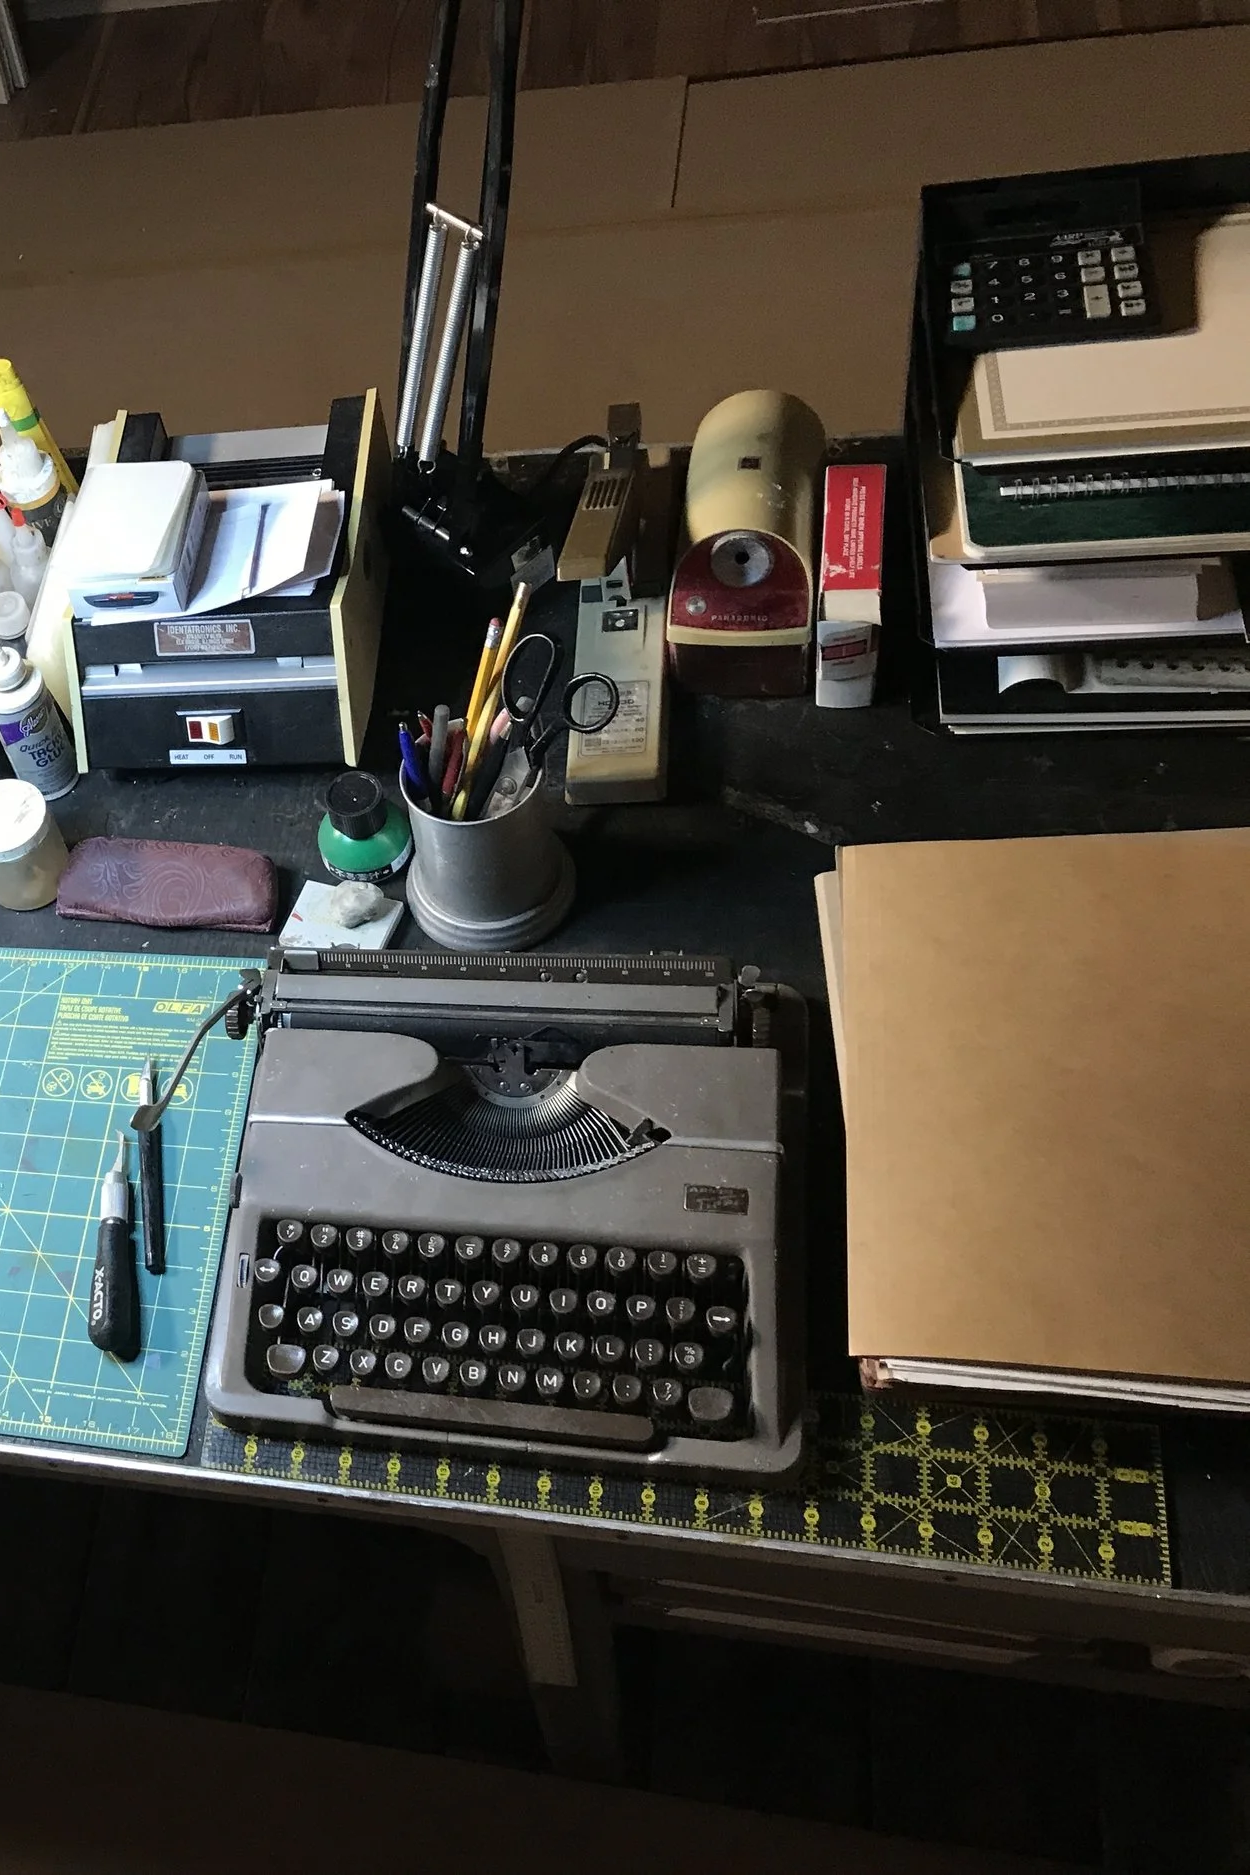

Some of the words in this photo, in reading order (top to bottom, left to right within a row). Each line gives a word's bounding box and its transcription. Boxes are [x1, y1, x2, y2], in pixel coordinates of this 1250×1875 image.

[1018, 258, 1031, 266] 8
[1051, 255, 1063, 263] 9
[986, 261, 998, 269] 7
[1054, 272, 1067, 280] 6
[988, 278, 1000, 286] 4
[1024, 292, 1036, 301] 2
[1057, 289, 1069, 298] 3
[991, 313, 1004, 323] 0
[154, 1002, 205, 1014] OLFA
[321, 1235, 327, 1244] 2
[357, 1239, 363, 1247] 3
[392, 1242, 399, 1250] 4
[428, 1245, 435, 1253] 5
[466, 1246, 473, 1255] 6
[503, 1250, 511, 1258] 7
[541, 1254, 548, 1263] 8
[580, 1256, 587, 1265] 9
[300, 1270, 310, 1282] Q
[333, 1275, 348, 1285] W
[370, 1278, 380, 1290] E
[407, 1281, 417, 1293] R
[91, 1266, 105, 1322] X-ACTO
[445, 1285, 455, 1296] T
[482, 1287, 492, 1299] Y
[520, 1290, 531, 1302] U
[561, 1295, 566, 1306] I
[596, 1297, 607, 1309] O
[636, 1301, 647, 1312] P
[304, 1314, 315, 1325] A
[341, 1317, 351, 1329] S
[378, 1321, 389, 1333] D
[413, 1324, 423, 1335] F
[451, 1328, 462, 1341] G
[488, 1332, 499, 1344] H
[528, 1336, 536, 1347] J
[566, 1339, 577, 1351] K
[606, 1343, 615, 1355] L
[321, 1350, 331, 1363] Z
[358, 1355, 369, 1368] X
[394, 1359, 404, 1372] C
[432, 1363, 442, 1375] V
[469, 1366, 479, 1379] B
[508, 1371, 518, 1384] N
[544, 1374, 557, 1386] M
